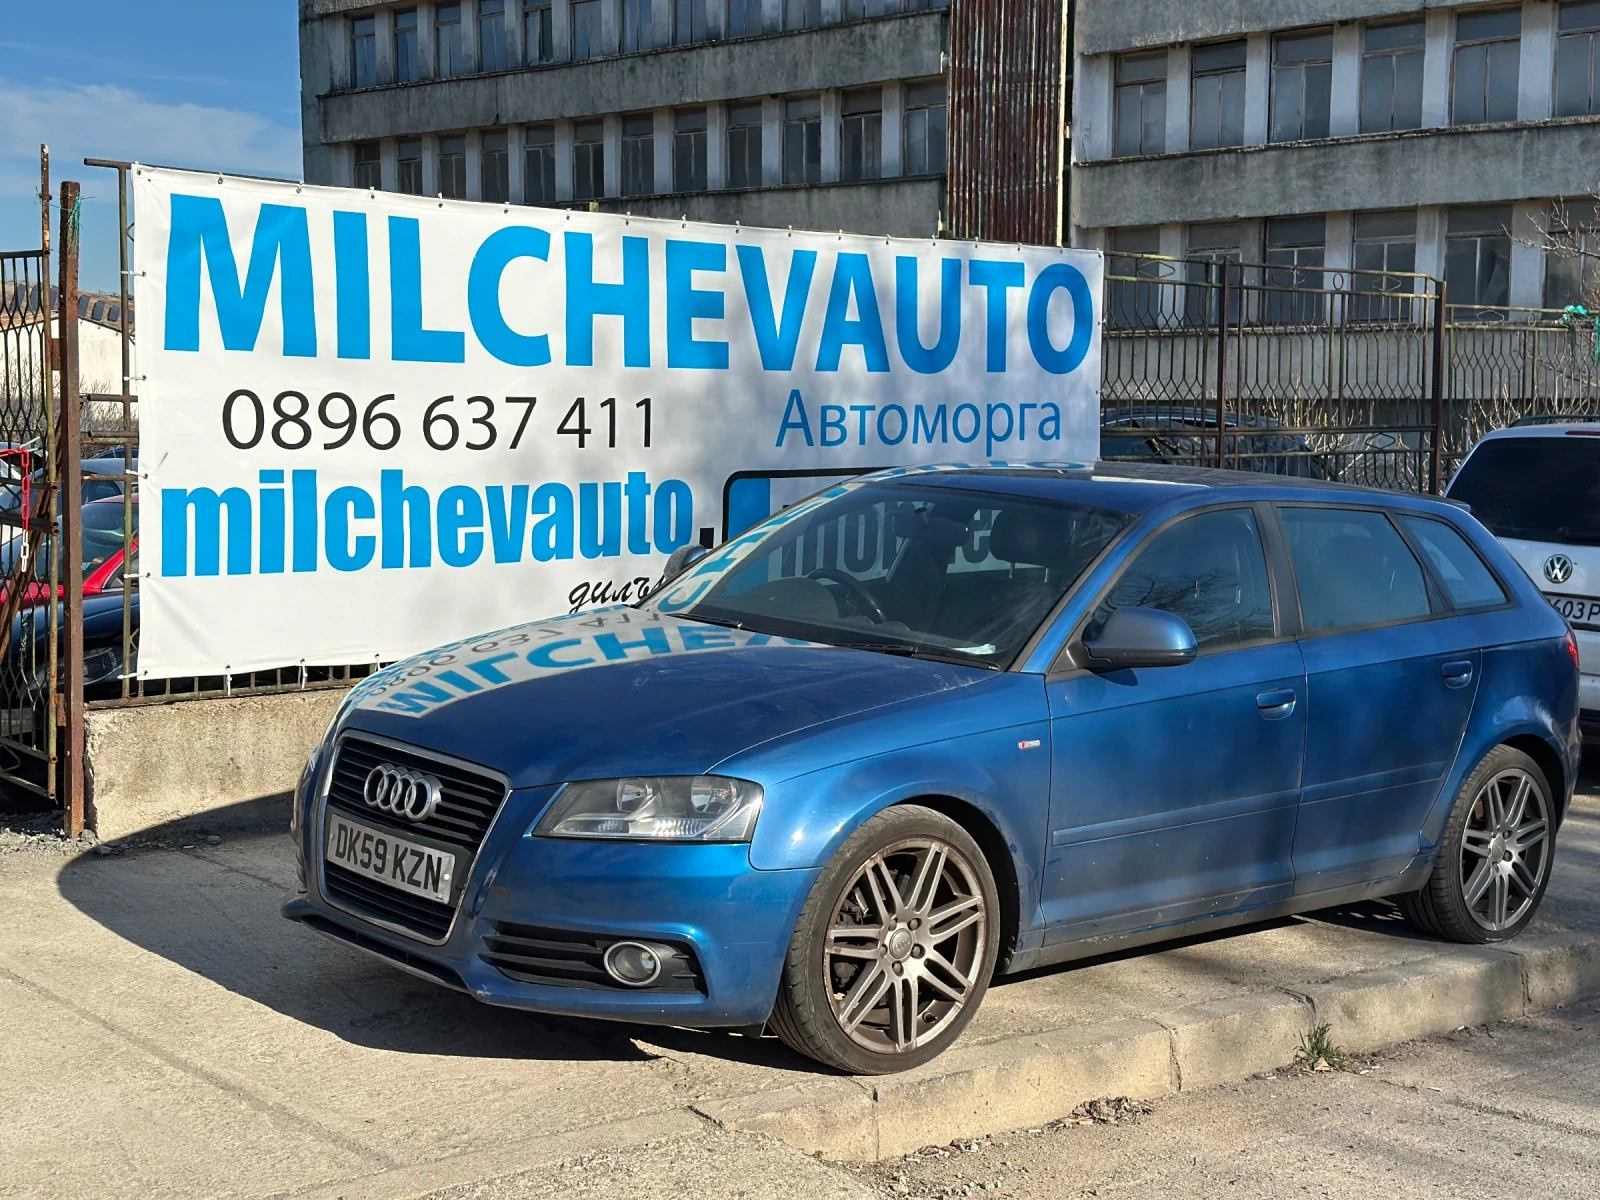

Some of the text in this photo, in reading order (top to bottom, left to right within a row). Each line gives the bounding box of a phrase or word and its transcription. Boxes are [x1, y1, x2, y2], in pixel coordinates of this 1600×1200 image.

[164, 194, 1093, 376] MILCHEVAUTO
[223, 390, 650, 450] 0896 637 411
[776, 389, 1062, 457] Автоморга
[335, 823, 443, 893] DK59 KZN
